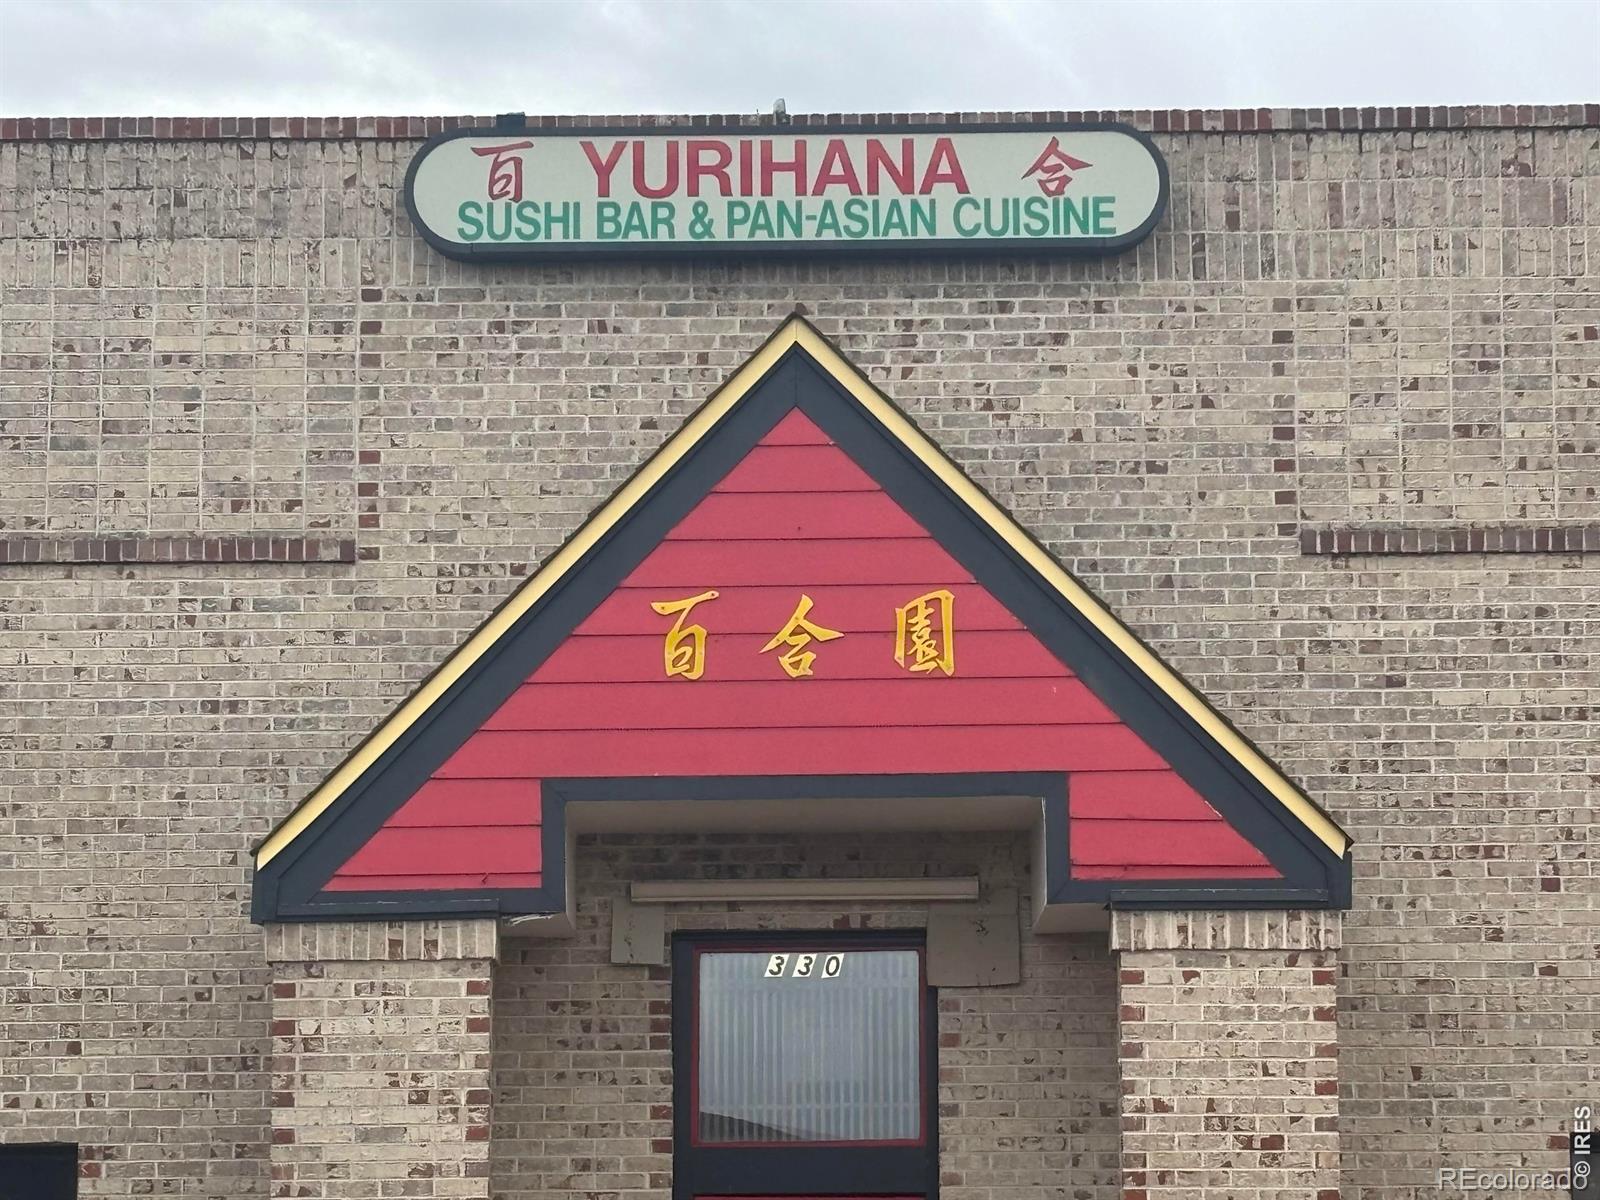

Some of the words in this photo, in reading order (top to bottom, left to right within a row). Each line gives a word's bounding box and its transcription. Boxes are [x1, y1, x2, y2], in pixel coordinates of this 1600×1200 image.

[470, 141, 534, 203] 百
[579, 138, 971, 199] YURIHANA
[1021, 136, 1094, 198] 合
[457, 200, 581, 241] SUSHI
[596, 200, 676, 240] BAR
[688, 200, 716, 240] &
[727, 198, 937, 239] PAN-ASIAN
[953, 196, 1117, 238] CUISINE
[768, 955, 841, 976] 330
